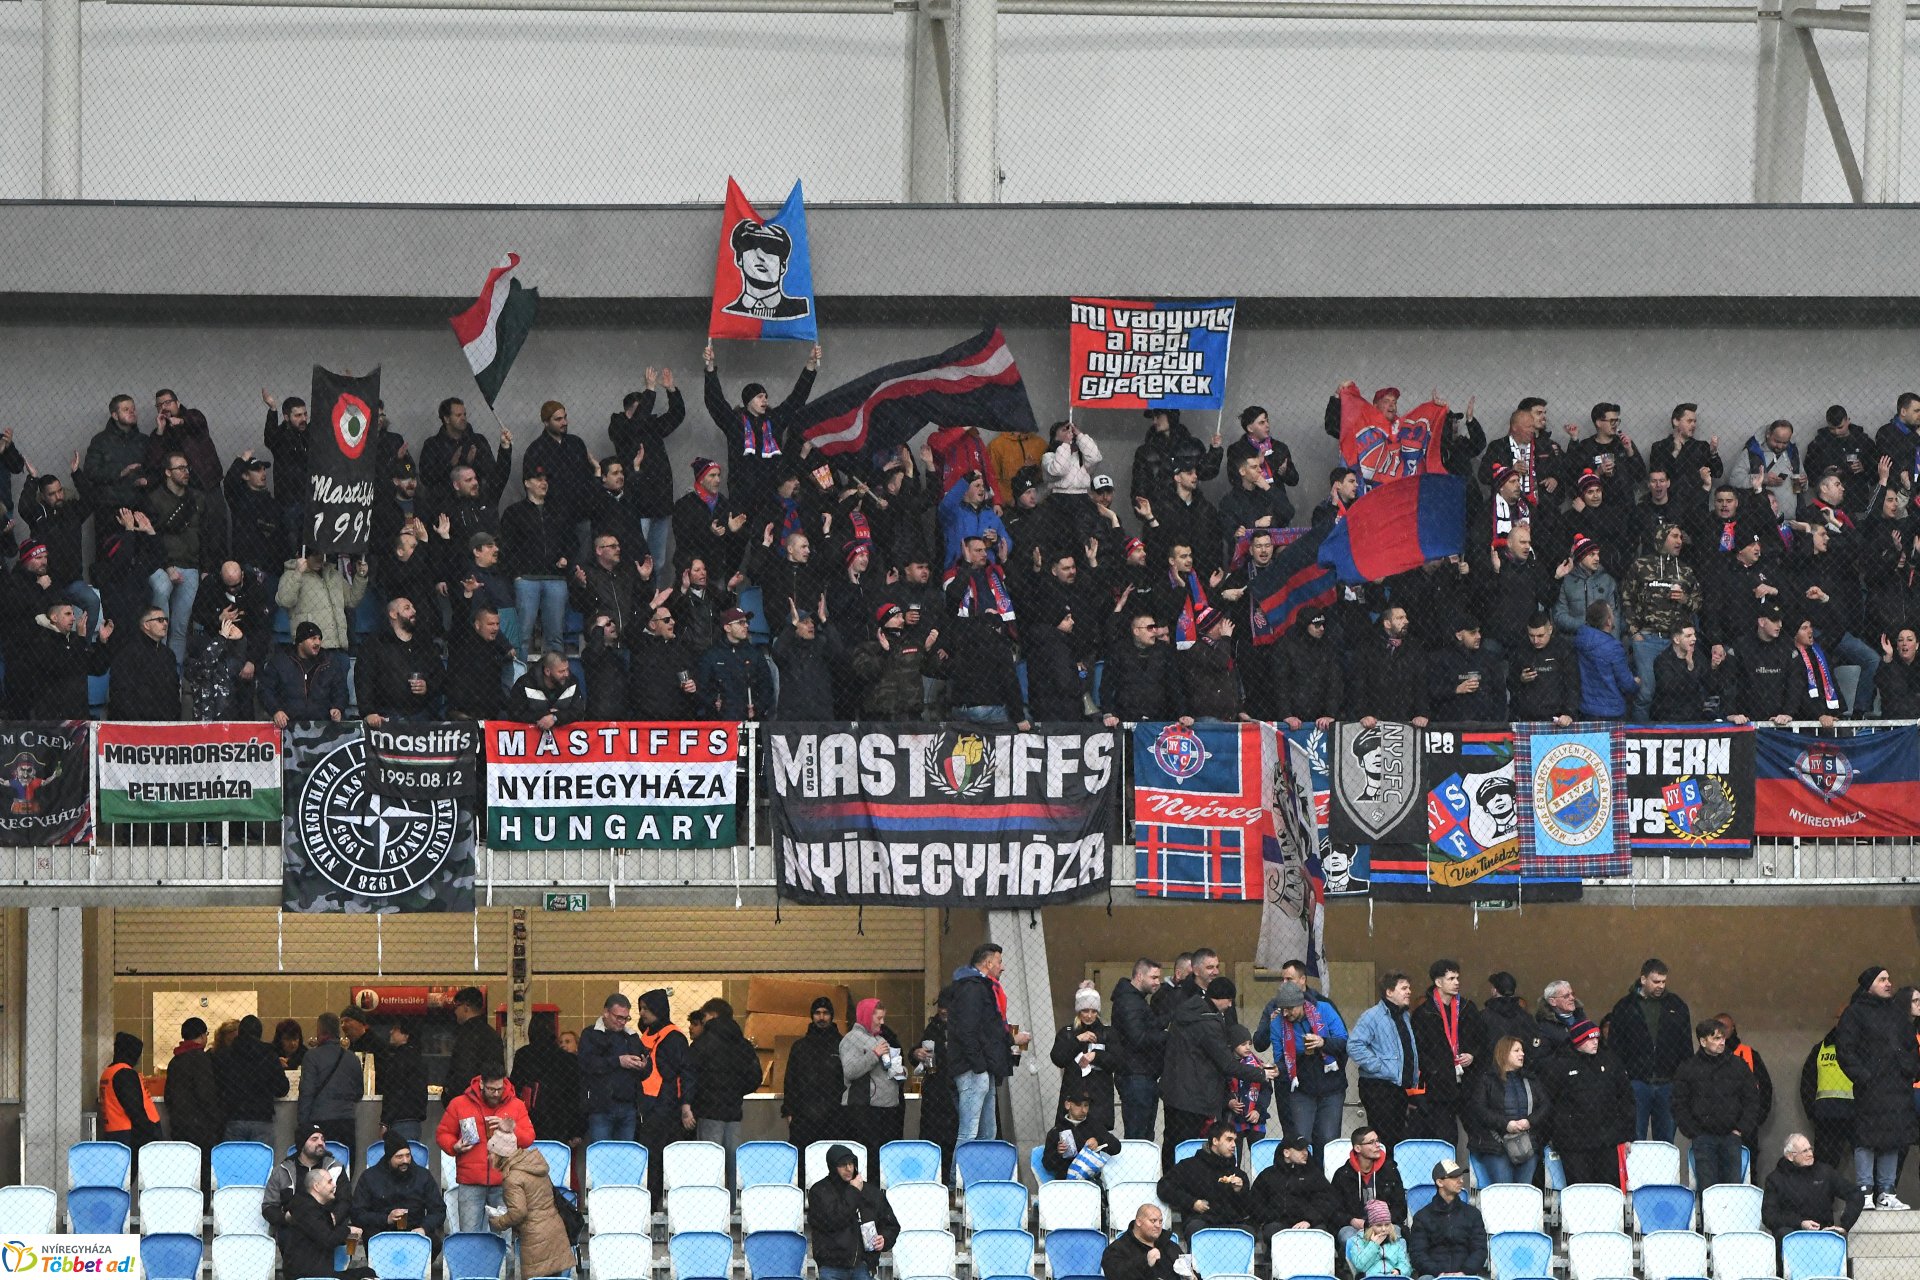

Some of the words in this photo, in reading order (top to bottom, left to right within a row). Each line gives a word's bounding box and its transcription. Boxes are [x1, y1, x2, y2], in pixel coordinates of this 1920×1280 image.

[1107, 333, 1124, 350] a
[105, 738, 275, 766] MAGYARORSZÁG
[371, 730, 470, 753] mastiffs
[498, 729, 728, 756] MASTIFFS
[805, 743, 815, 791] 1995
[1383, 724, 1404, 803] NYSFC
[1625, 738, 1731, 775] STERN
[1825, 760, 1833, 770] S
[128, 775, 253, 801] PETNEHÁZA
[333, 770, 367, 809] MAS
[380, 768, 463, 787] 1995.08.12
[498, 770, 727, 800] NYÍREGYHÁZA
[1445, 784, 1466, 811] S
[1665, 788, 1680, 806] NY
[1685, 784, 1696, 801] S
[305, 762, 341, 872] NYÍREGYHÁZA
[500, 814, 725, 842] HUNGARY
[1677, 811, 1686, 827] F
[1788, 807, 1867, 828] NYÍREGYHÁZA
[333, 824, 366, 861] 1995
[387, 821, 428, 865] SINCE
[1449, 830, 1468, 858] F
[783, 831, 1105, 897] NYÍREGYHÁZA
[1450, 865, 1478, 882] Vén
[358, 874, 397, 891] 1928
[381, 996, 425, 1005] felfrissülés
